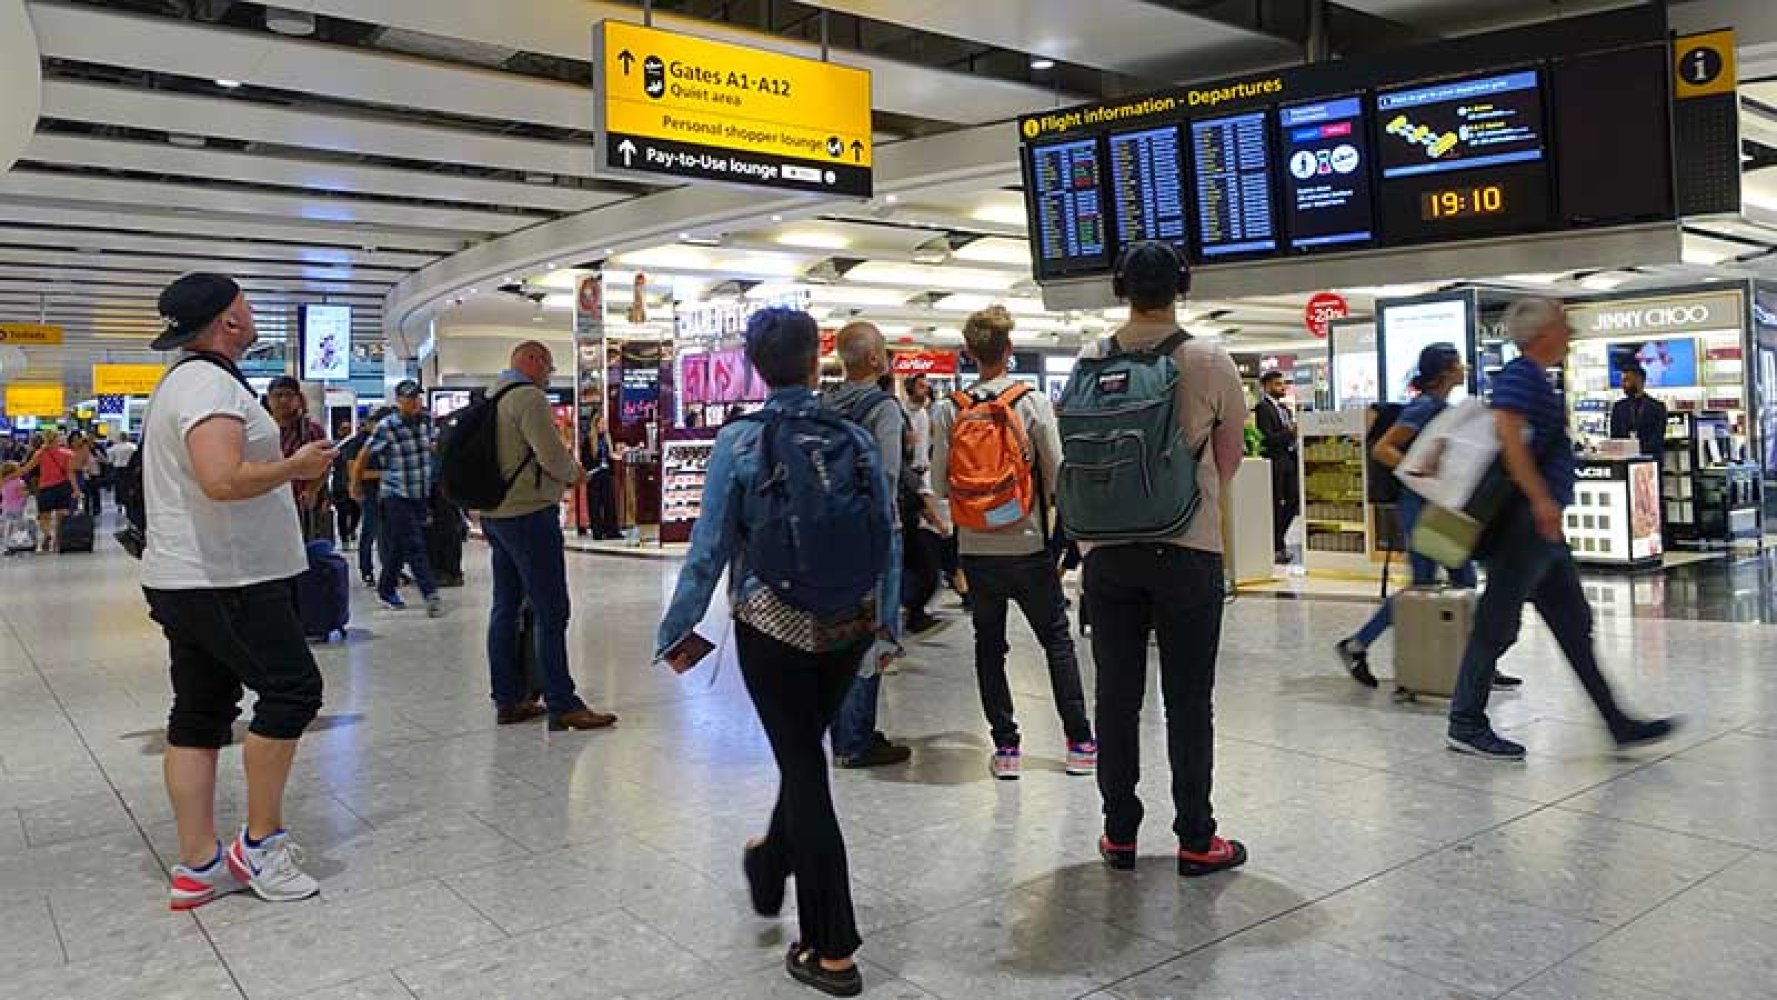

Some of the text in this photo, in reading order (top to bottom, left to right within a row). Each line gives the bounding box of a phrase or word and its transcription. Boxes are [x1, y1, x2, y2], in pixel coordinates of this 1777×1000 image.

[670, 61, 791, 97] Gates A1-A12
[670, 83, 742, 106] Quiet area
[1041, 112, 1082, 133] Flight
[1084, 97, 1175, 124] information
[1188, 77, 1282, 106] Departures
[662, 114, 823, 151] Personal shopper lounge
[646, 146, 727, 172] Pay-to-Use
[730, 158, 778, 179] lounge
[1429, 186, 1501, 217] 19:10
[1592, 304, 1709, 330] JIMMY CHOO
